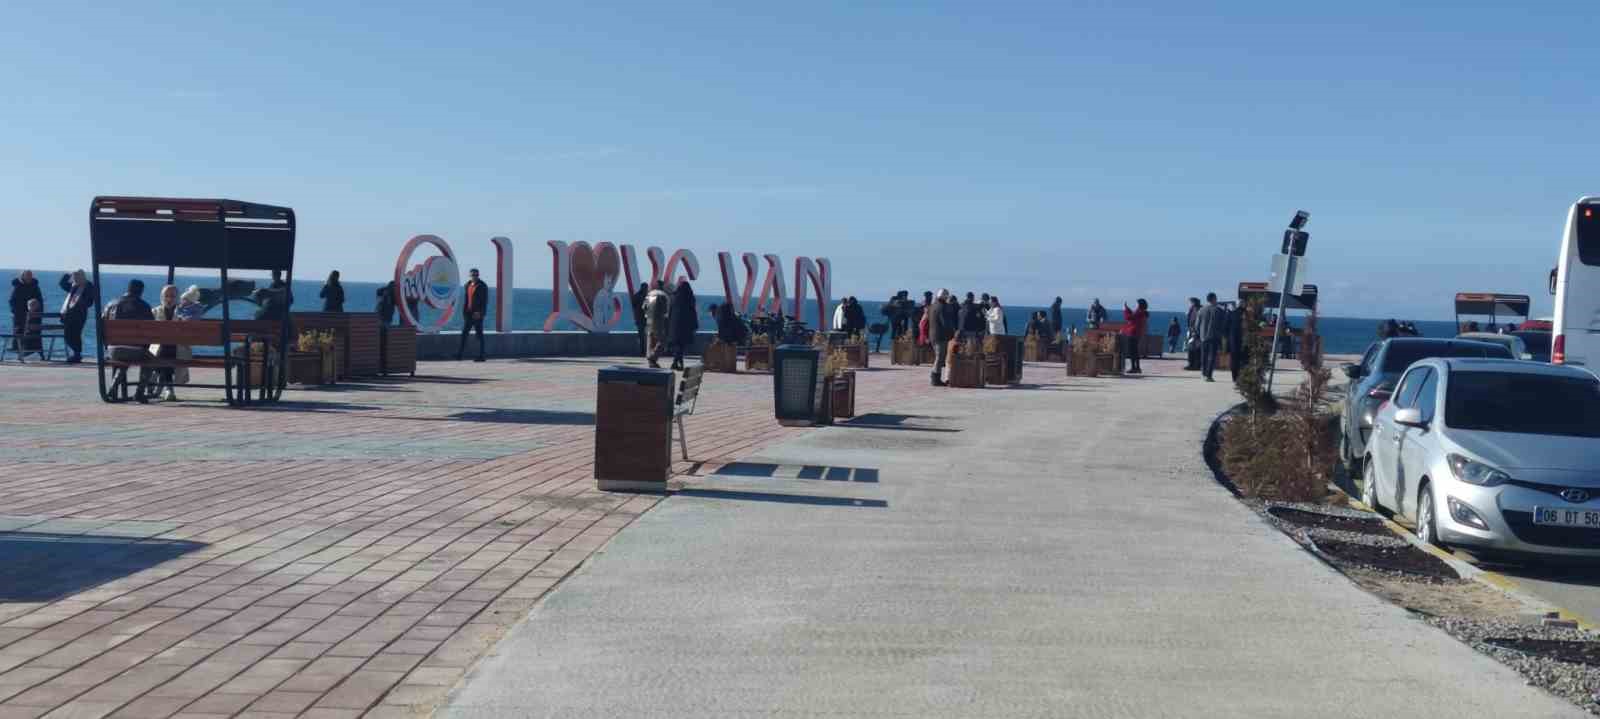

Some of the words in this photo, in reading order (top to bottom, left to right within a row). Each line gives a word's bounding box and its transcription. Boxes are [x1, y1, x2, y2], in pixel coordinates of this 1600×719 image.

[491, 236, 513, 332] I
[718, 251, 832, 332] VAN
[1584, 512, 1600, 525] 50
